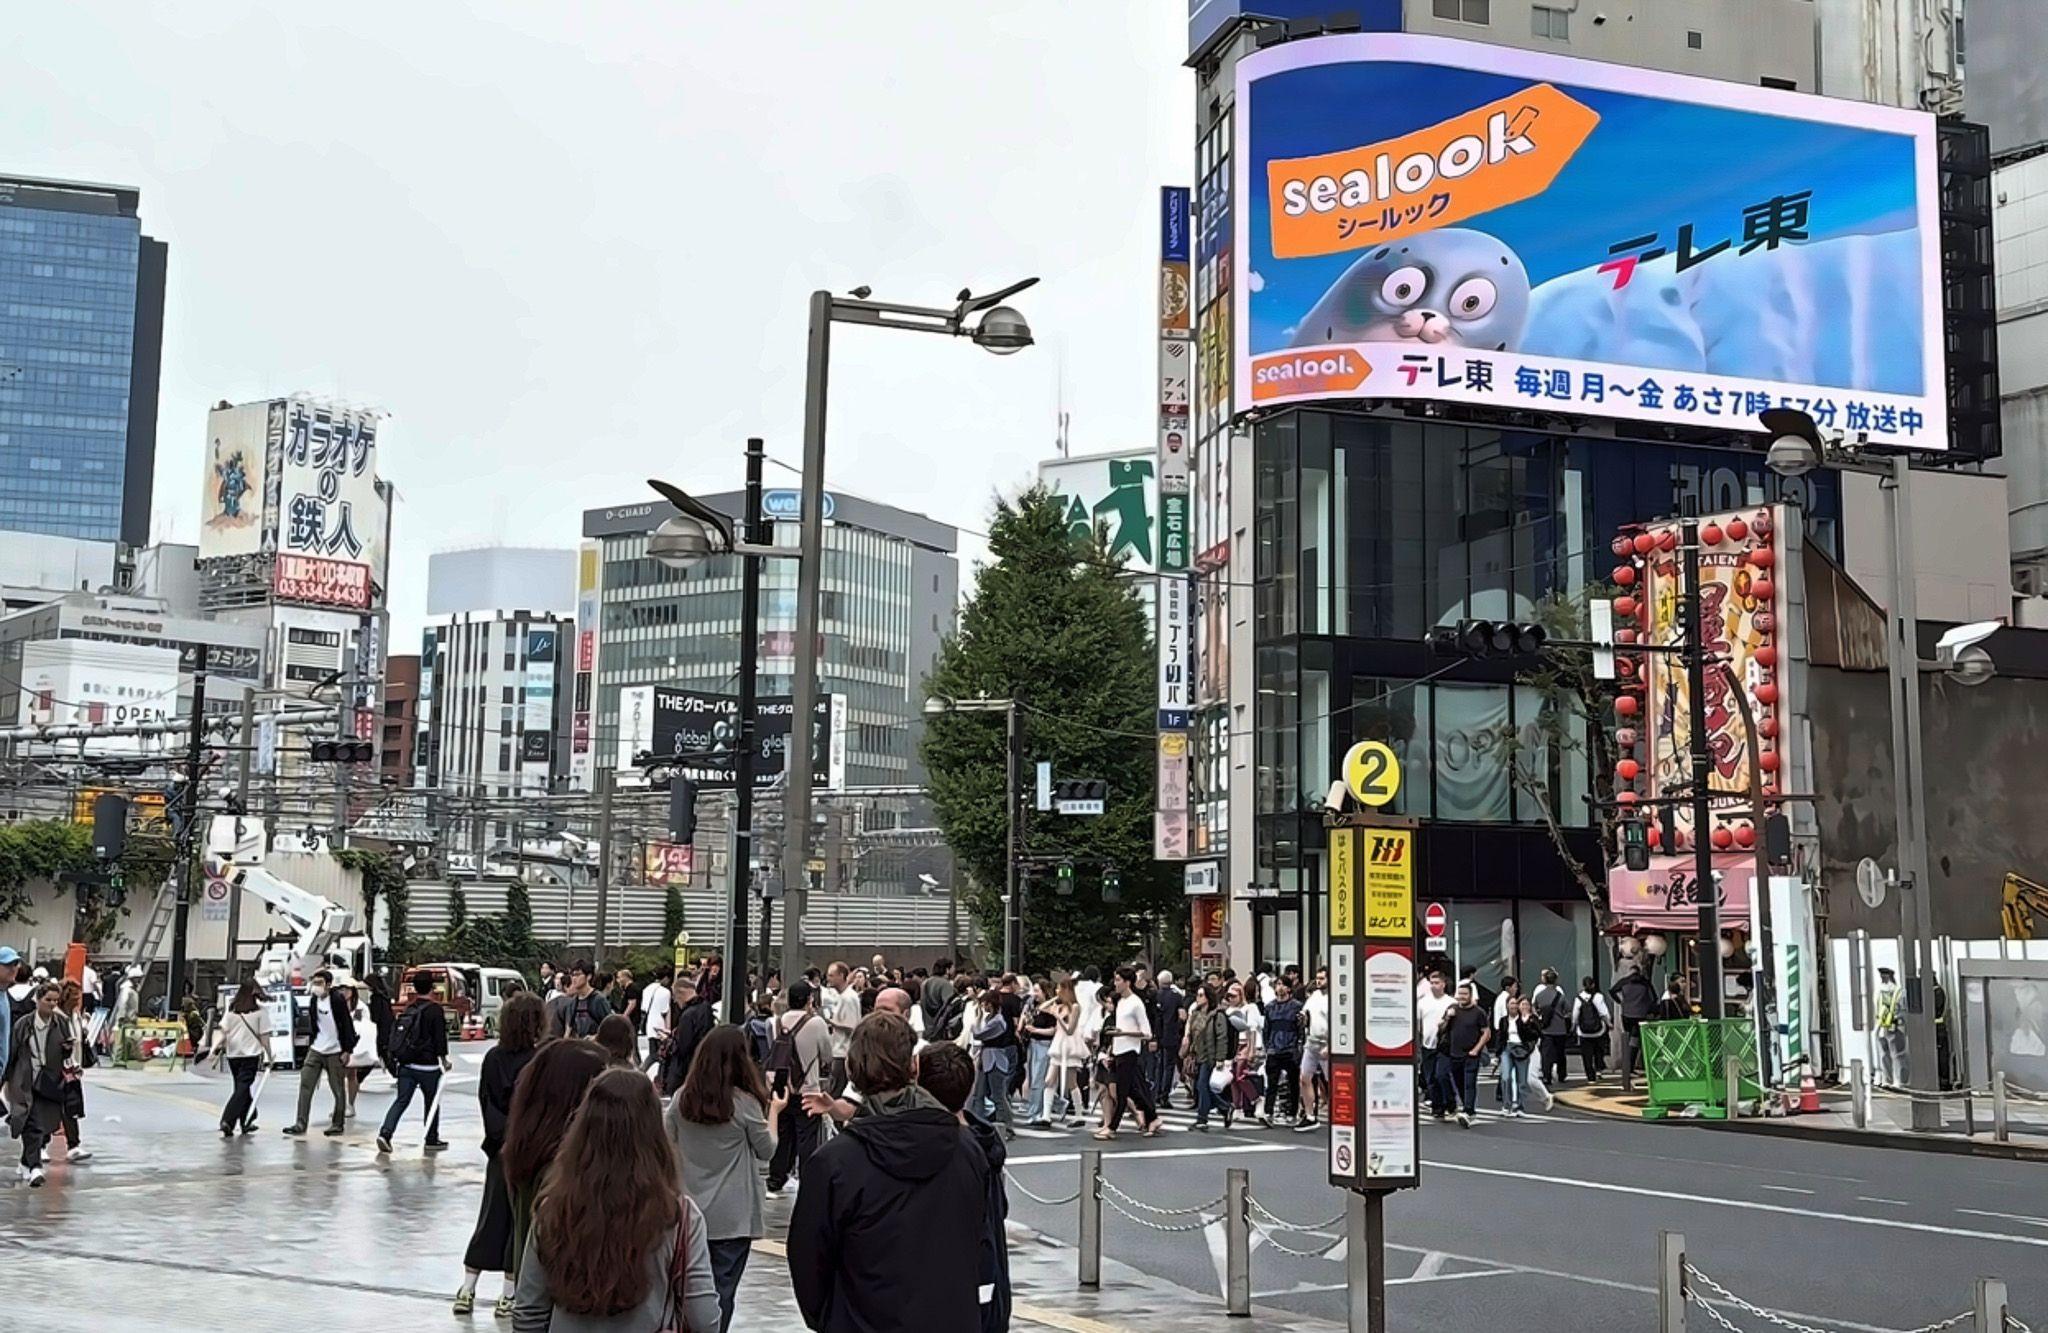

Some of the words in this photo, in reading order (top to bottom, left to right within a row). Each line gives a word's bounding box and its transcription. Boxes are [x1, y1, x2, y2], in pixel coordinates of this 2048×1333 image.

[1282, 106, 1539, 215] sealook
[1337, 192, 1450, 240] シールック
[1597, 190, 1813, 289] テレ東
[1397, 354, 1494, 392] テレ東
[1514, 365, 1571, 400] 毎週
[1846, 401, 1924, 436] 放送中
[286, 402, 376, 478] カラオケ
[318, 467, 339, 504] の
[288, 493, 362, 559] 鉄人
[116, 704, 166, 723] OPEN
[1167, 713, 1180, 726] 1F
[675, 727, 711, 753] global
[1360, 749, 1388, 795] 2
[1369, 916, 1407, 929] はとバス
